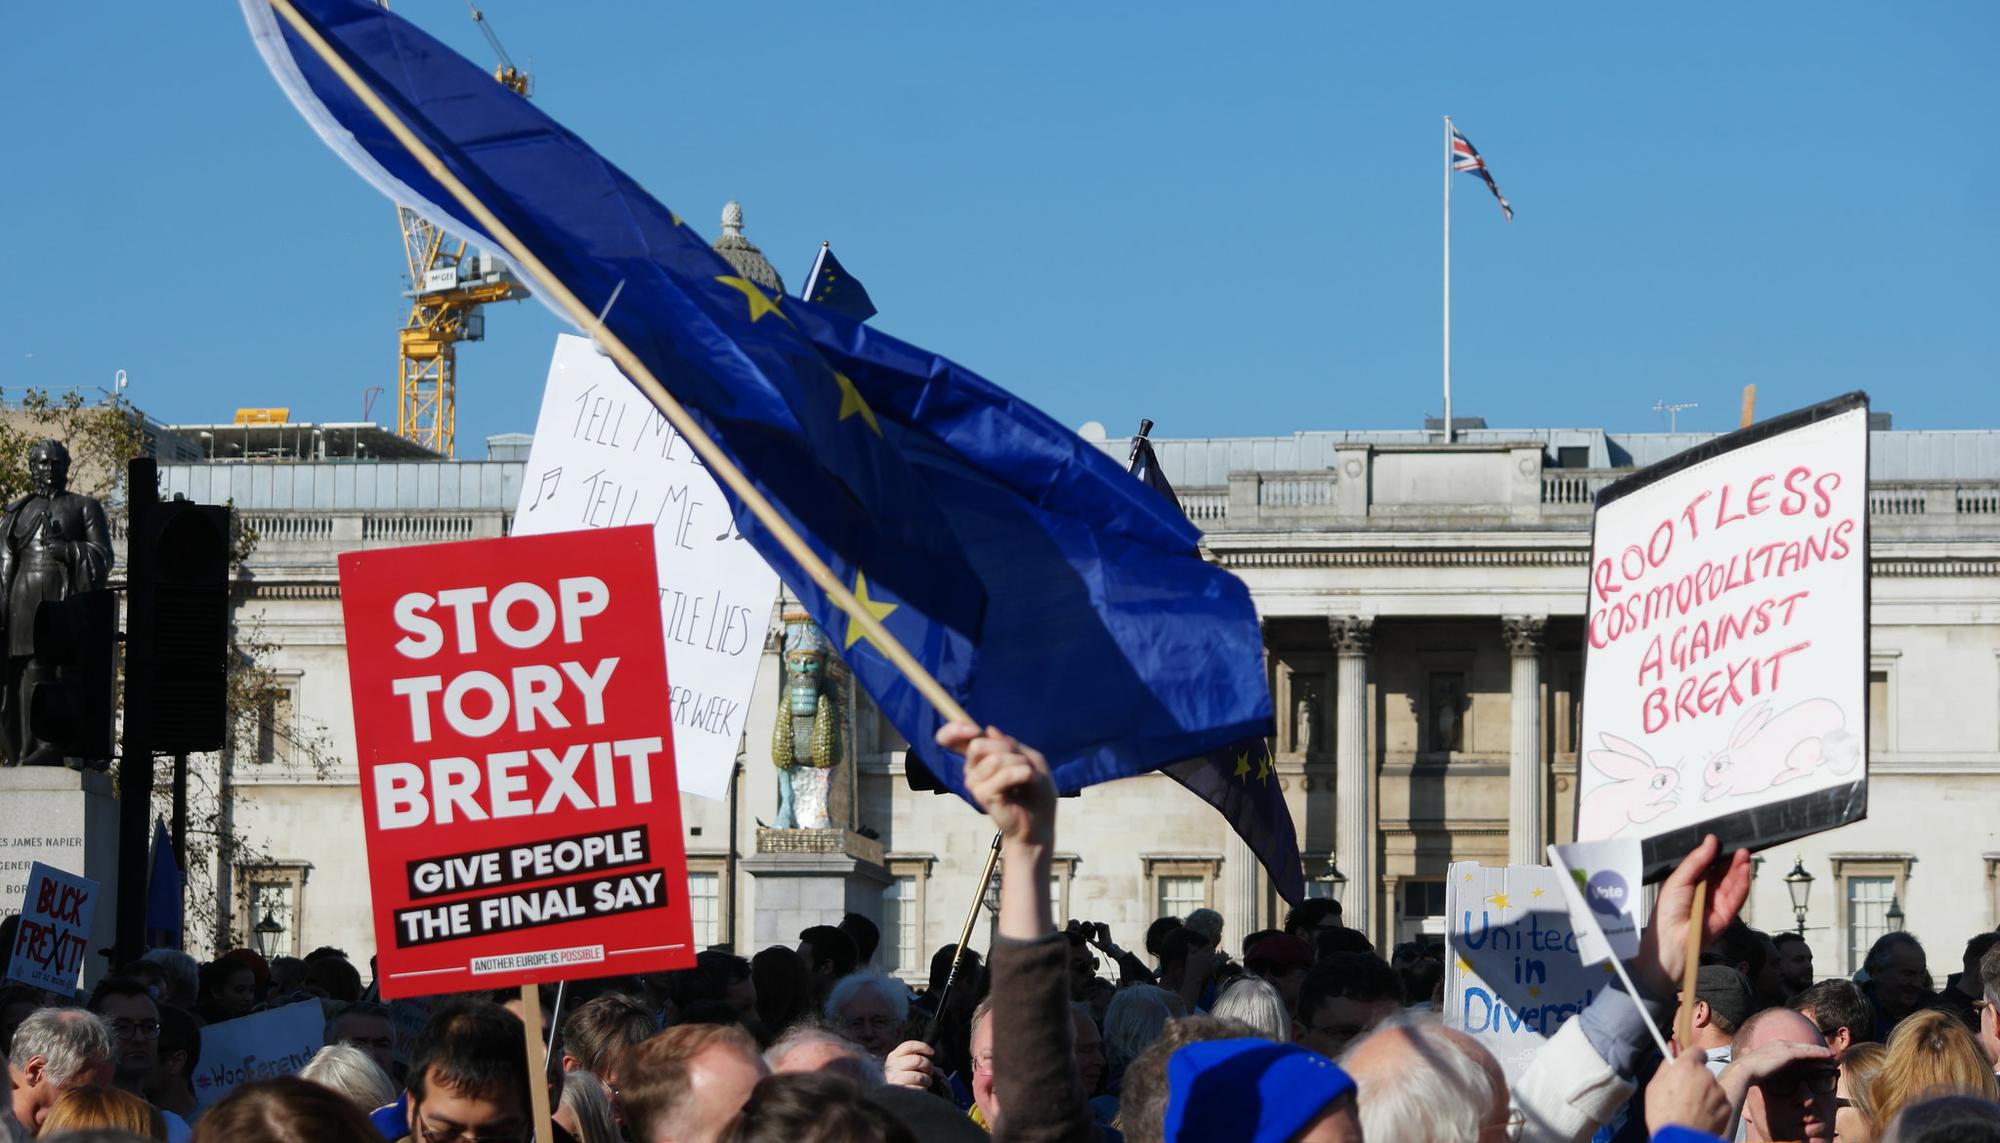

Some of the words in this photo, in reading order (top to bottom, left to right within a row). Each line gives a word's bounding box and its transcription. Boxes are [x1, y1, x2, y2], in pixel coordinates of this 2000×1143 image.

[573, 384, 626, 447] TELL
[582, 469, 638, 528] TELL
[653, 485, 703, 549] ME
[1593, 466, 1841, 602] ROOTLESS
[393, 575, 609, 659] STOP
[1588, 519, 1854, 649] COSMOPOLITANS
[705, 590, 752, 656] LIES
[1638, 591, 1809, 687] AGAINST
[392, 657, 620, 742] TORY
[668, 684, 692, 725] ER
[690, 693, 738, 736] WEEK
[1642, 641, 1810, 734] BREXIT
[373, 736, 663, 830] BREXIT
[11, 837, 42, 847] JAMES
[46, 837, 82, 847] NAPIER
[413, 853, 501, 894] GIVE
[511, 830, 643, 880] PEOPLE
[36, 876, 89, 927] BUCK
[401, 902, 471, 942] THE
[481, 886, 584, 930] FINAL
[598, 872, 663, 911] SAY
[15, 919, 88, 975] FREXIT!
[474, 957, 515, 972] ANOTHER
[516, 953, 549, 968] EUROPE
[551, 953, 560, 964] IS
[560, 947, 600, 962] POSSIBLE
[1514, 956, 1547, 984] in
